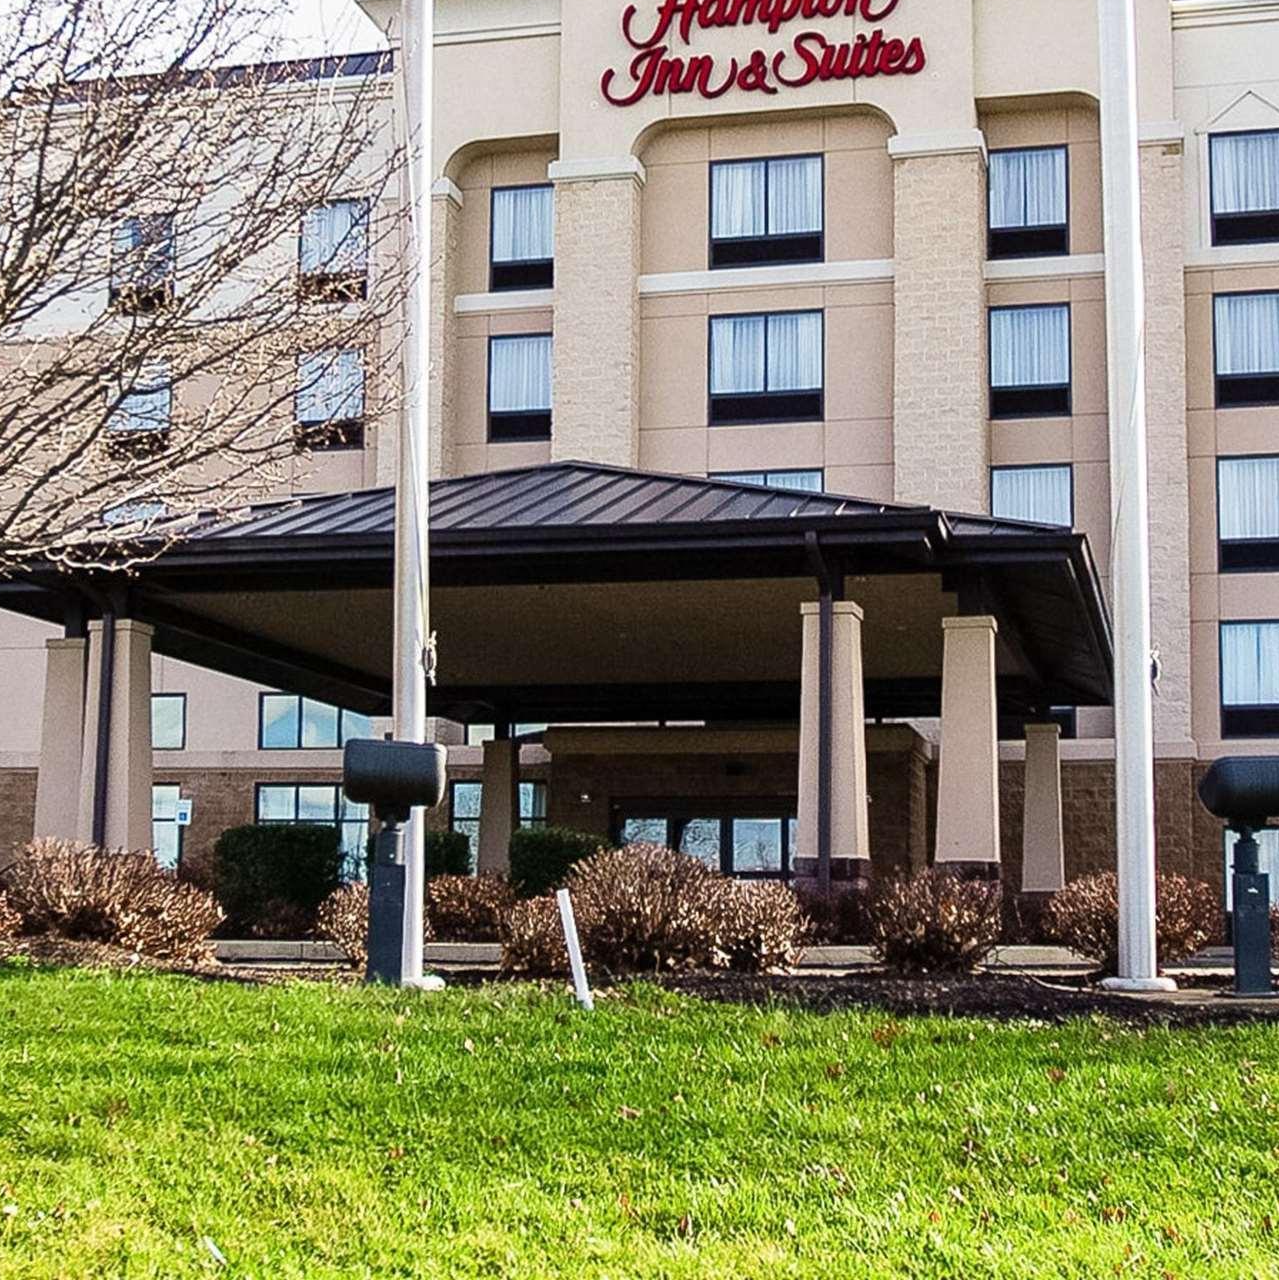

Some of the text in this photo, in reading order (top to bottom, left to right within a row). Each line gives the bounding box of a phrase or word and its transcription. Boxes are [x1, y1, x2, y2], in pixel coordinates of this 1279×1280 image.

[601, 29, 925, 107] Inn & Suites
